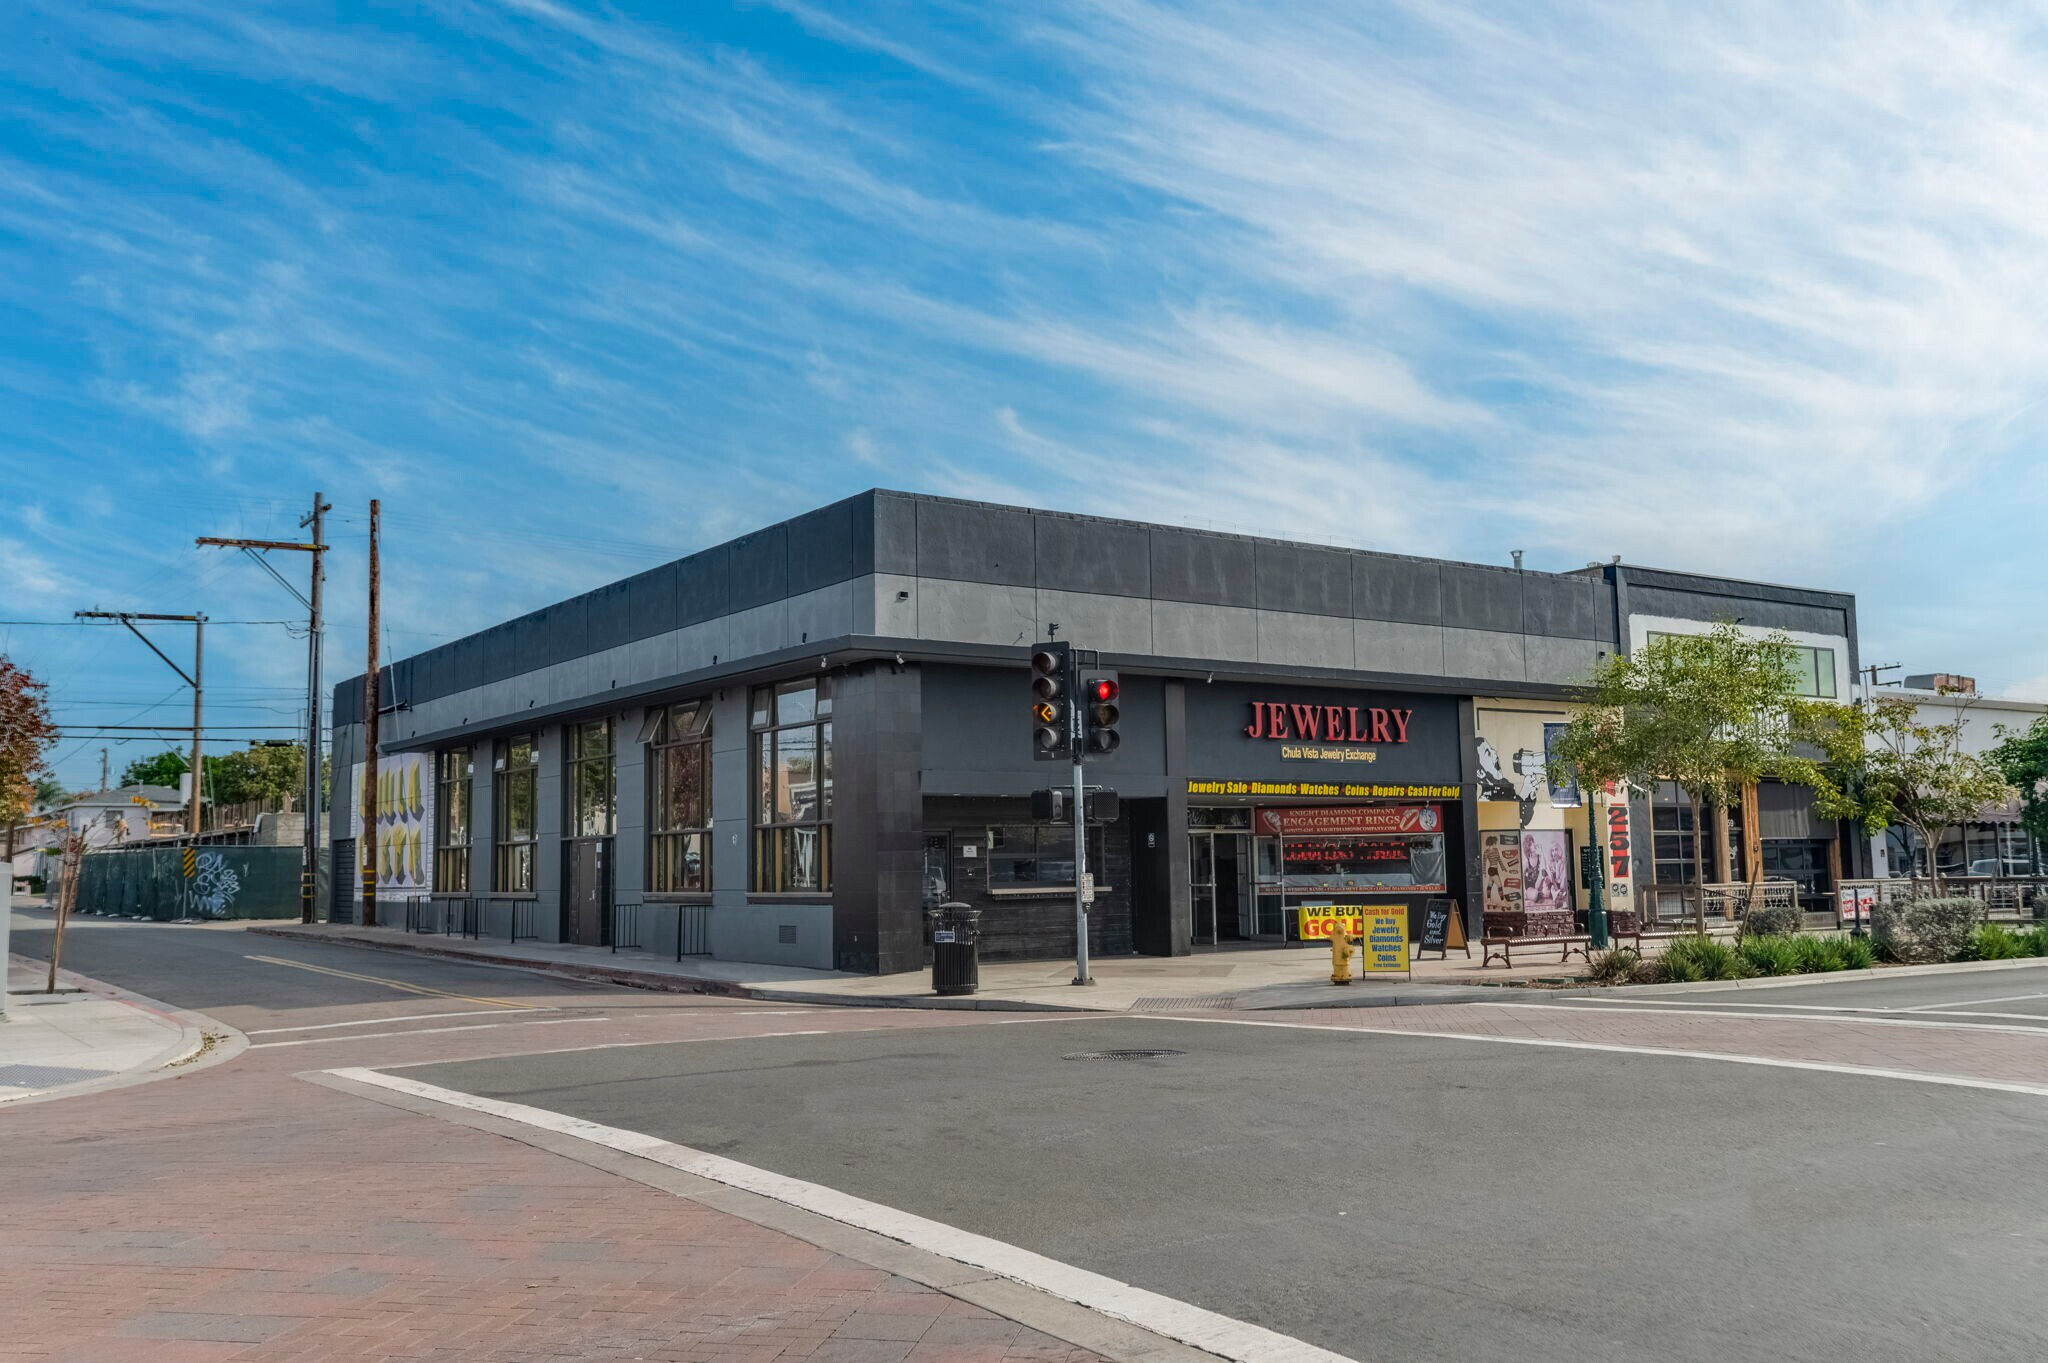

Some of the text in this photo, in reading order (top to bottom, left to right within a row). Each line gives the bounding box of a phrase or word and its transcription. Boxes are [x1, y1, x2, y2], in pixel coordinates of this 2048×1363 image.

[1248, 701, 1412, 743] JEWELRY
[1281, 746, 1376, 763] Chula Vista Jewelry Exchange
[1188, 781, 1460, 799] Jewelry Sale Diamonds Watches Coins Repairs Cash For Gold
[1321, 808, 1357, 816] DIAMOND
[1283, 815, 1401, 826] ENGAGEMENT RINGS
[1307, 907, 1363, 917] WE BUY
[1426, 919, 1443, 928] Gold
[1372, 926, 1400, 935] Jewelry
[1424, 934, 1444, 944] Silver
[1371, 944, 1402, 952] Watches
